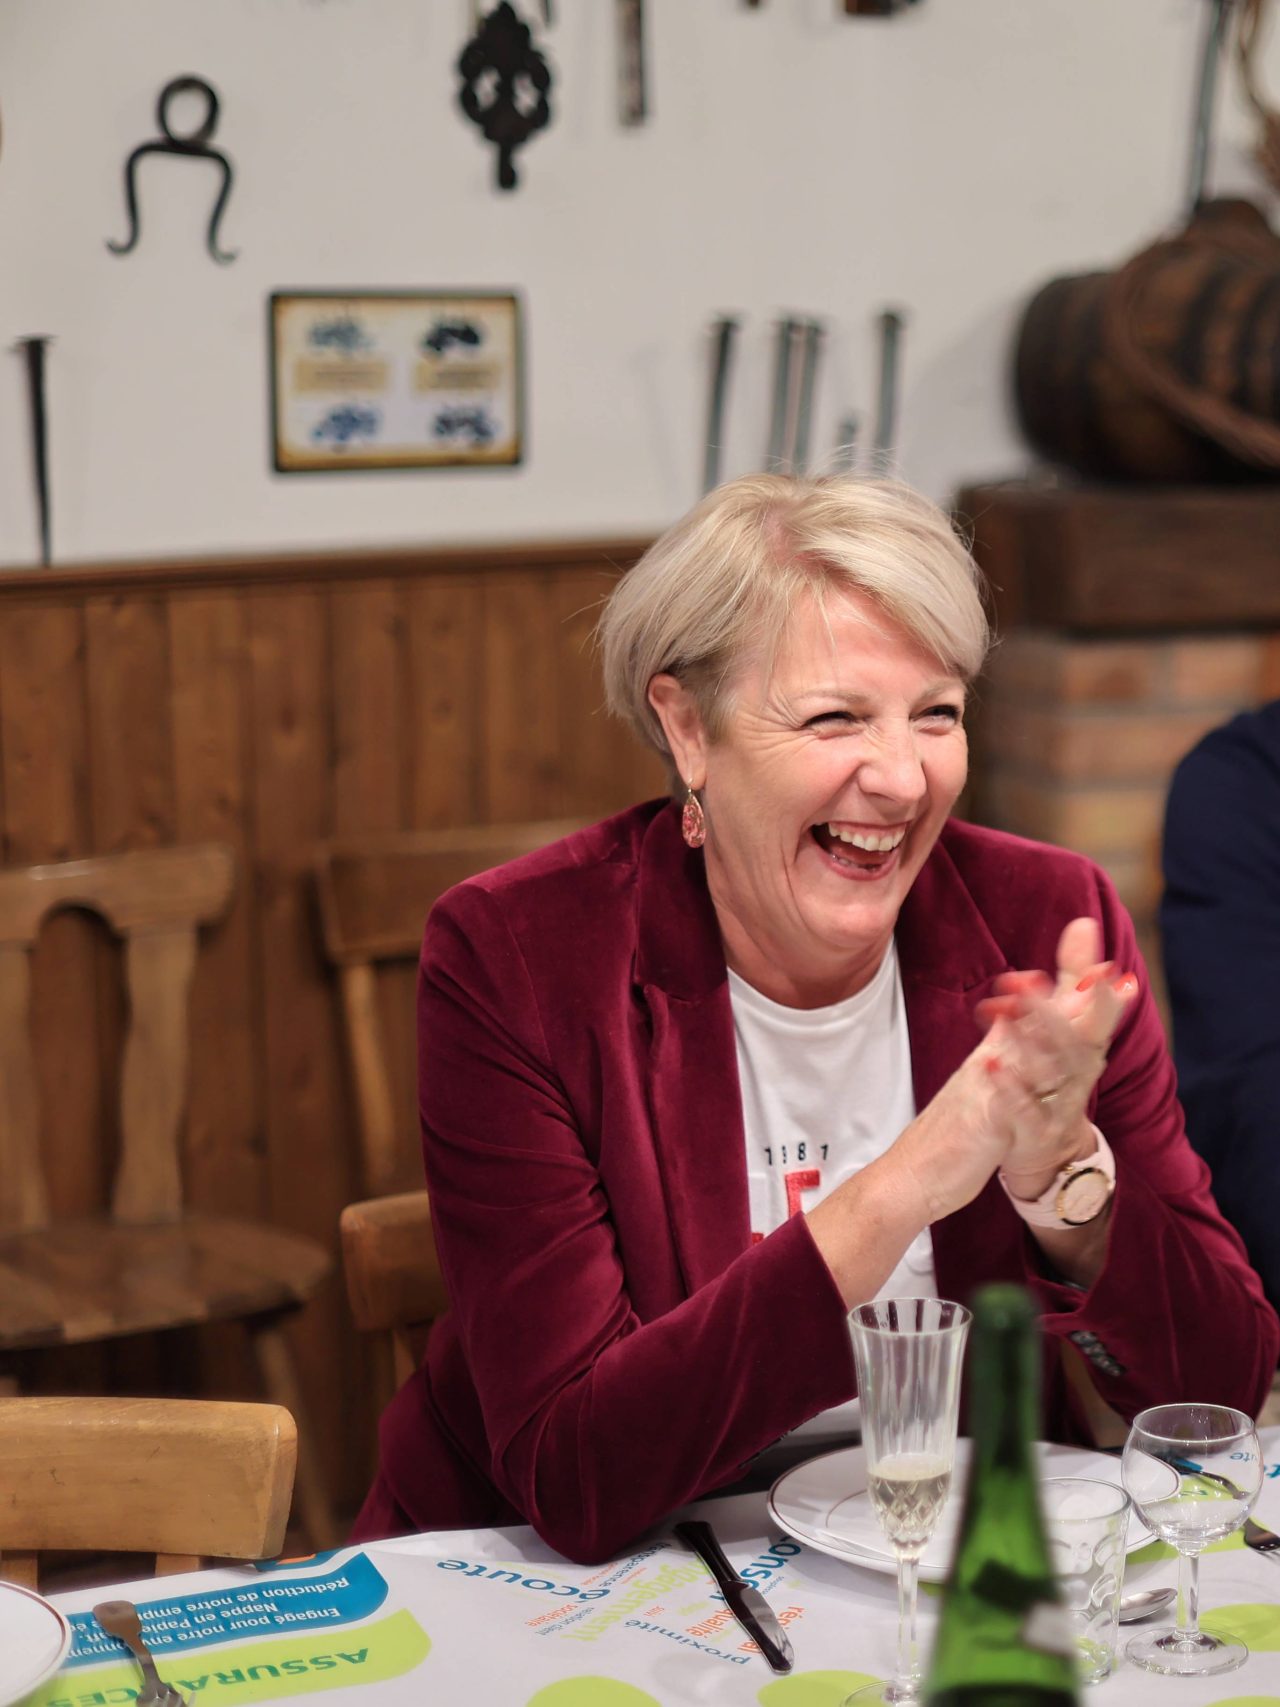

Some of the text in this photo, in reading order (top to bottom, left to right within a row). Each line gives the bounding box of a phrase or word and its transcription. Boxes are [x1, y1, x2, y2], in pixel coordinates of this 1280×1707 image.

[262, 1577, 350, 1599] Réduction
[437, 1559, 611, 1604] écoute
[185, 1596, 232, 1613] notre
[236, 1592, 260, 1602] de
[560, 1557, 708, 1642] ngagement
[220, 1602, 279, 1618] Nappe
[274, 1607, 341, 1625] Engagé
[141, 1618, 191, 1635] Papie
[194, 1613, 216, 1625] en
[229, 1615, 271, 1631] pour
[176, 1624, 226, 1643] notre
[624, 1620, 752, 1665] proximité
